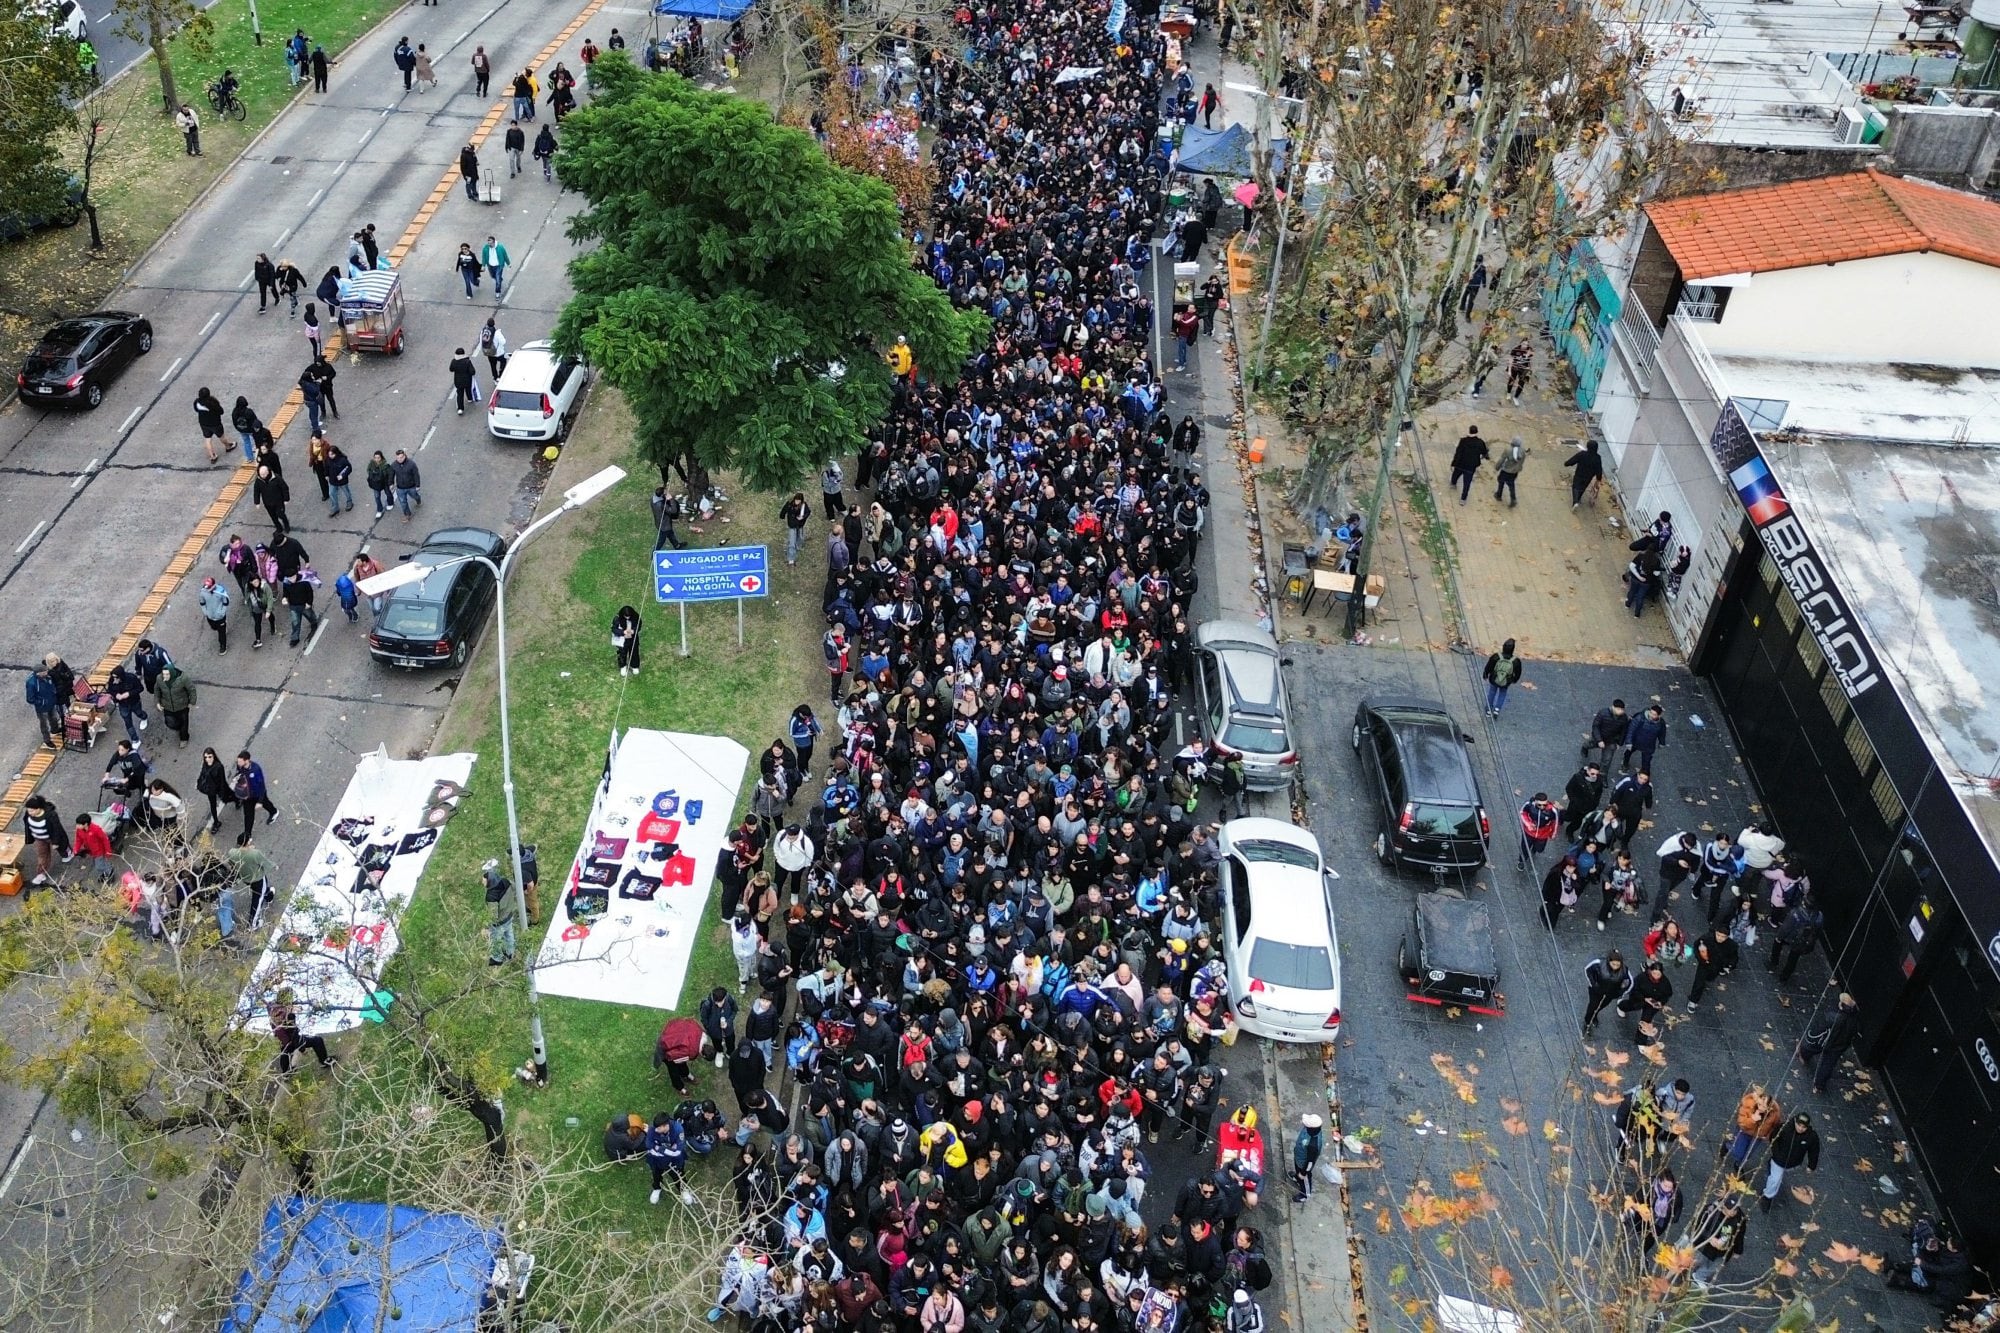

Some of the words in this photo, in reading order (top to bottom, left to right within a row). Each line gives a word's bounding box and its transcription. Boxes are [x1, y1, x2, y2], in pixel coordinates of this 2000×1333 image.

[678, 555, 725, 564] JUZGADO
[727, 553, 740, 562] DE
[742, 552, 761, 560] PAZ
[684, 575, 732, 584] HOSPITAL
[681, 584, 702, 592] ANA
[703, 582, 737, 591] GOITIA
[1768, 516, 1878, 694] Berini
[1760, 528, 1805, 601] EXCLUSIVE
[1801, 601, 1822, 633] CAR
[1818, 633, 1859, 699] SERVICE
[1431, 971, 1444, 980] 80
